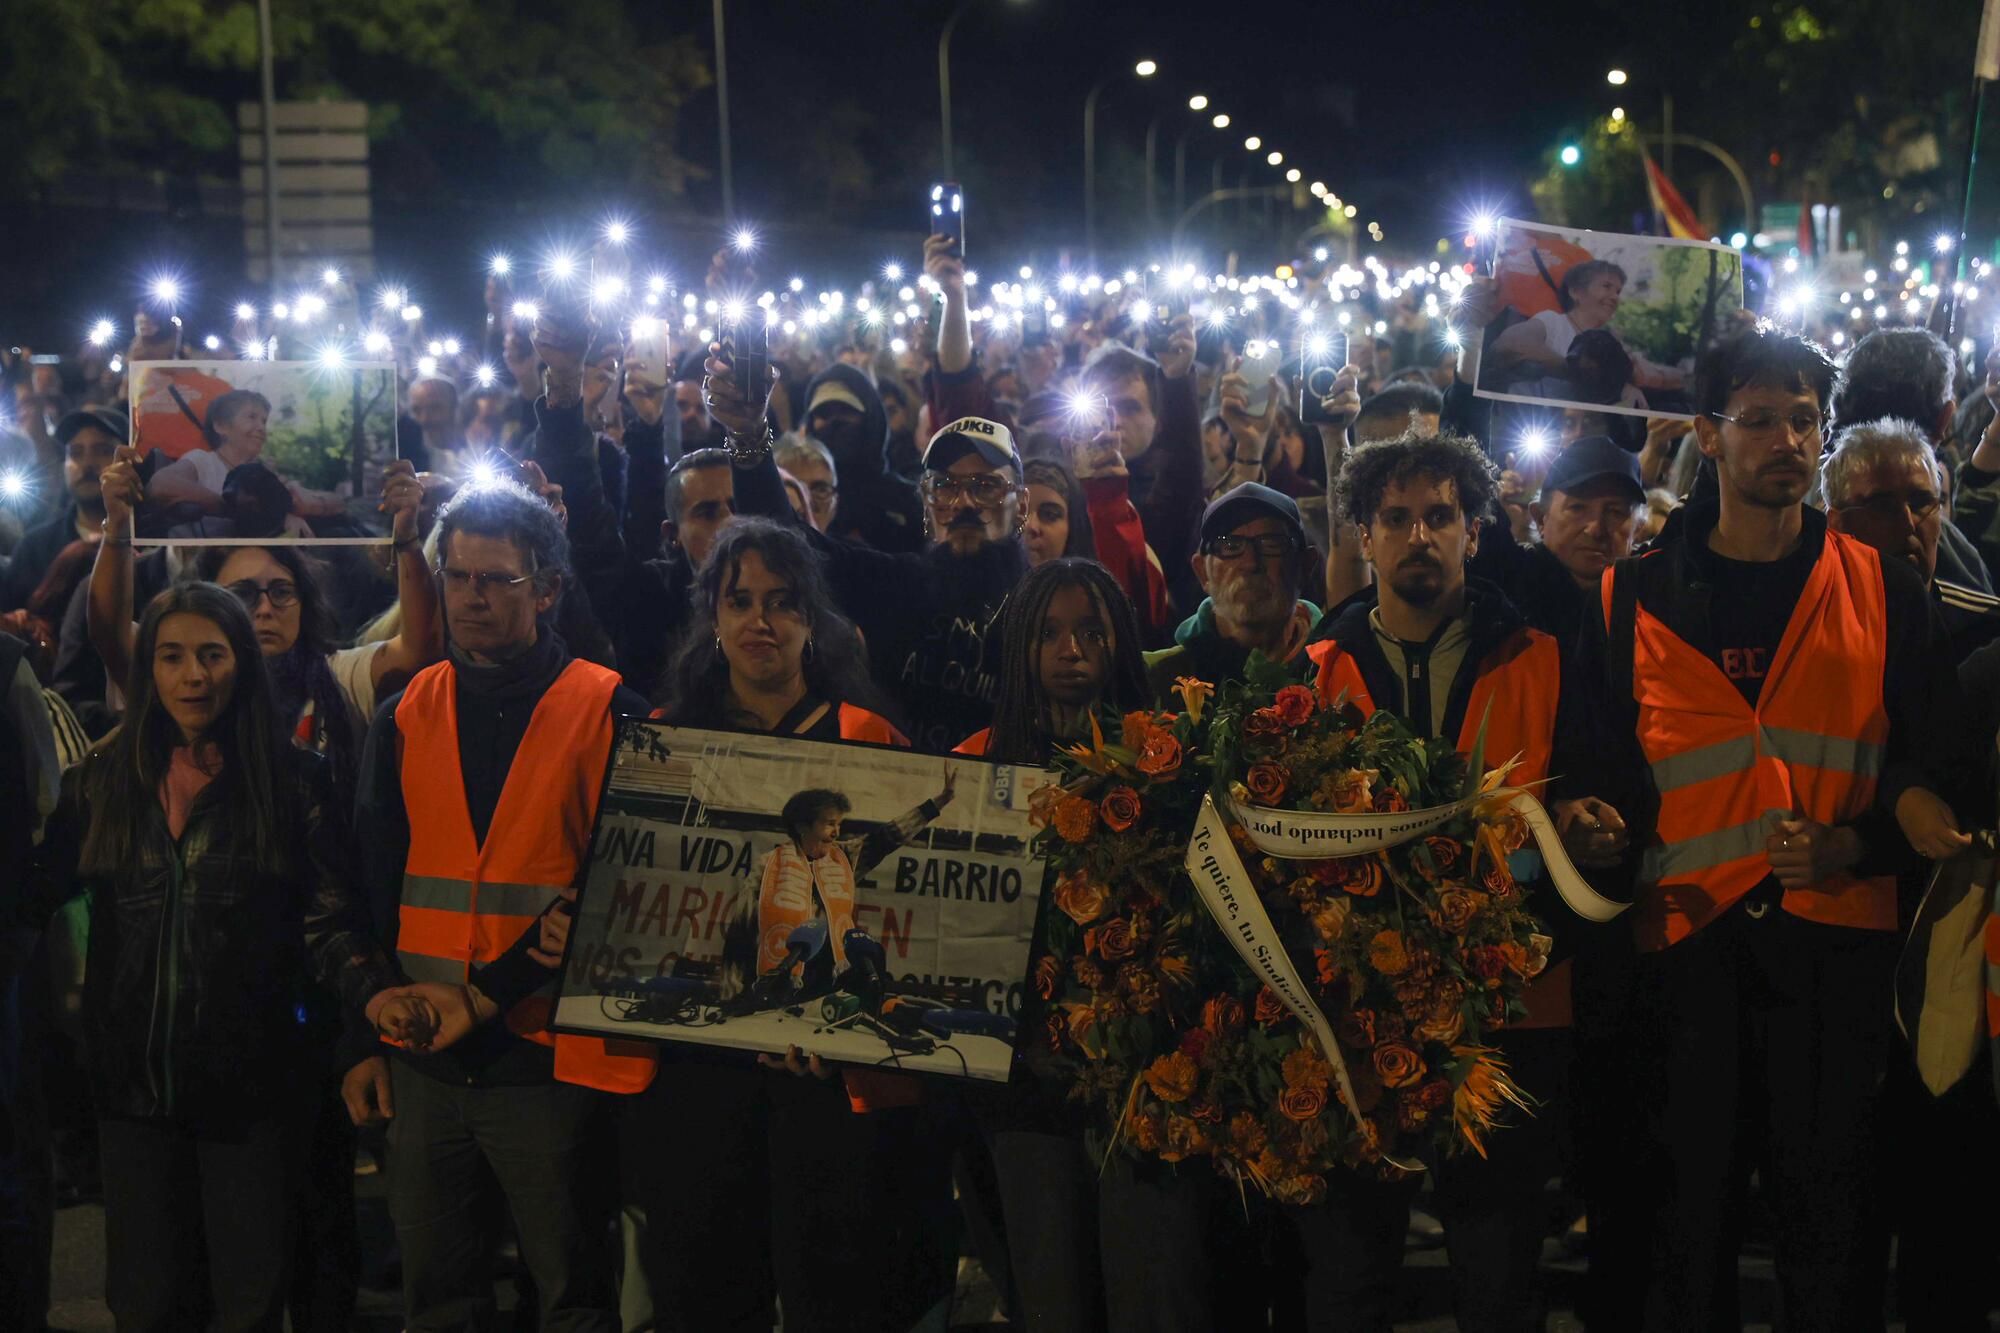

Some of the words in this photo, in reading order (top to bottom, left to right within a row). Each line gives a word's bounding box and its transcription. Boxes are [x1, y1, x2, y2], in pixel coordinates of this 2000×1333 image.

[1194, 826, 1212, 853] Te
[1253, 820, 1282, 836] por
[1288, 827, 1383, 844] luchando
[592, 826, 656, 869] UNA
[680, 834, 753, 878] VIDA
[894, 856, 1022, 903] BARRIO
[1201, 855, 1239, 921] quiere,
[1238, 922, 1256, 943] tu
